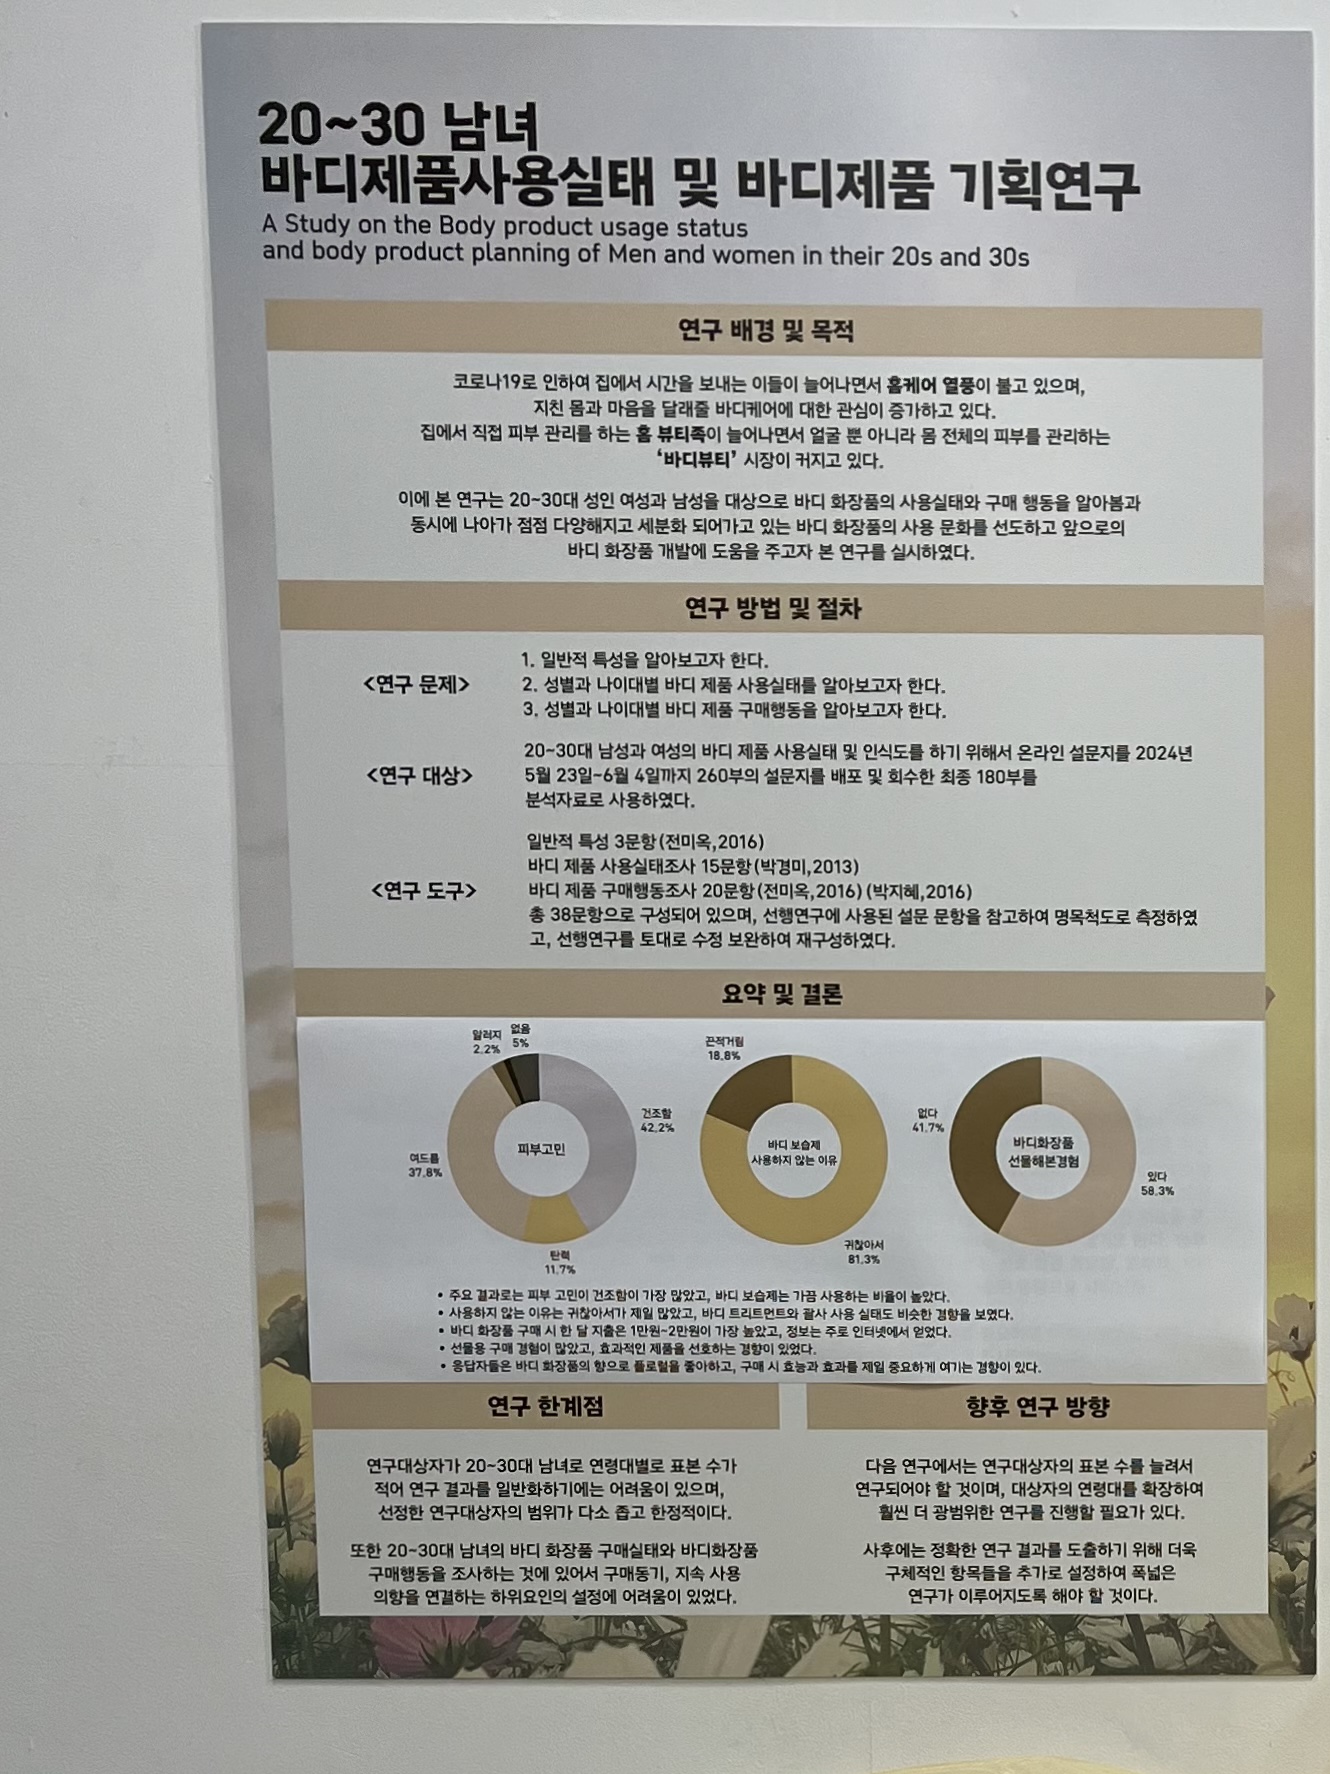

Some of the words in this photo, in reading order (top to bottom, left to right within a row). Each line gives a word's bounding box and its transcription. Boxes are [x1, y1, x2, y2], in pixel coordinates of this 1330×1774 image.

[258, 102, 424, 146] 20~30
[443, 101, 538, 153] 남녀
[261, 152, 655, 208] 바디제품사용실태
[674, 156, 718, 209] 및
[737, 157, 934, 210] 바디제품
[950, 158, 1140, 212] 기획연구
[261, 213, 278, 234] A
[285, 213, 351, 239] Study
[358, 218, 388, 235] on
[394, 213, 432, 236] the
[440, 214, 496, 239] Body
[504, 215, 594, 241] product
[600, 220, 669, 244] usage
[677, 218, 749, 239] status
[262, 238, 304, 260] and
[312, 236, 367, 265] body
[374, 239, 464, 265] product
[472, 242, 571, 267] planning
[577, 242, 600, 262] of
[608, 237, 656, 263] Men
[664, 243, 704, 264] and
[712, 249, 794, 264] women
[802, 244, 822, 265] in
[829, 244, 884, 266] their
[892, 245, 932, 266] 20s
[940, 246, 980, 266] and
[989, 246, 1029, 267] 30s
[678, 318, 722, 341] 연구
[730, 318, 774, 342] 배경
[782, 319, 803, 343] 및
[810, 319, 853, 343] 목적
[743, 451, 790, 469] 시장이
[795, 451, 842, 469] 커지고
[846, 452, 883, 469] 있다.
[685, 596, 729, 619] 연구
[736, 596, 780, 620] 방법
[789, 596, 809, 620] 및
[817, 596, 862, 620] 절차
[521, 651, 534, 667] 1.
[541, 651, 587, 669] 일반적
[592, 651, 639, 669] 특성을
[644, 651, 725, 669] 알아보고자
[730, 651, 768, 669] 한다.
[363, 673, 413, 694] <연구
[418, 674, 469, 694] 문제>
[366, 765, 416, 786] <연구
[422, 765, 472, 786] 대상>
[525, 791, 604, 809] 분석자료로
[608, 791, 695, 809] 사용하였다.
[527, 832, 572, 850] 일반적
[578, 832, 608, 850] 특성
[371, 881, 421, 900] <연구
[426, 881, 476, 901] 도구>
[722, 983, 766, 1005] 요약
[773, 983, 793, 1005] 및
[800, 983, 843, 1006] 결론
[472, 1029, 501, 1041] 알러지
[510, 1023, 530, 1034] 없음
[512, 1037, 529, 1047] 5%
[705, 1034, 744, 1048] 끈적거림
[473, 1043, 500, 1054] 2.2%
[708, 1050, 741, 1062] 18.8%
[641, 1107, 672, 1119] 건조함
[917, 1106, 938, 1120] 없다
[640, 1122, 674, 1133] 42.2%
[912, 1122, 944, 1132] 41.7%
[517, 1142, 565, 1156] 피부고민
[767, 1139, 787, 1150] 바디
[790, 1139, 820, 1151] 보습제
[1013, 1136, 1074, 1150] 바디화장품
[409, 1152, 439, 1164] 여드름
[751, 1154, 792, 1167] 사용하지
[795, 1154, 815, 1167] 않는
[817, 1154, 838, 1167] 이유
[1008, 1154, 1079, 1168] 선물해본경험
[408, 1167, 442, 1178] 37.8%
[1147, 1171, 1167, 1182] 있다
[1141, 1185, 1174, 1196] 58.3%
[844, 1239, 884, 1251] 귀찮아서
[550, 1249, 570, 1261] 탄력
[848, 1254, 880, 1264] 81.3%
[544, 1264, 576, 1274] 11.7%
[450, 1341, 486, 1355] 선물용
[489, 1342, 513, 1355] 구매
[516, 1341, 550, 1355] 경험이
[554, 1342, 594, 1356] 많았고,
[599, 1342, 645, 1355] 효과적인
[649, 1342, 685, 1355] 제품을
[688, 1342, 736, 1355] 선호하는
[739, 1342, 774, 1356] 경향이
[777, 1342, 816, 1355] 있었다.
[488, 1395, 531, 1417] 연구
[537, 1395, 603, 1417] 한계점
[966, 1395, 1010, 1418] 향후
[1016, 1396, 1059, 1418] 연구
[1066, 1396, 1110, 1418] 방향
[378, 1504, 424, 1521] 선정한
[429, 1504, 521, 1521] 연구대상자의
[527, 1504, 573, 1521] 범위가
[578, 1504, 610, 1520] 다소
[614, 1504, 645, 1520] 좁고
[650, 1504, 731, 1521] 한정적이다.
[908, 1588, 954, 1604] 연구가
[958, 1588, 1047, 1604] 이루어지도록
[1051, 1587, 1083, 1604] 해야
[1088, 1587, 1104, 1604] 할
[1108, 1587, 1157, 1604] 것이다.
